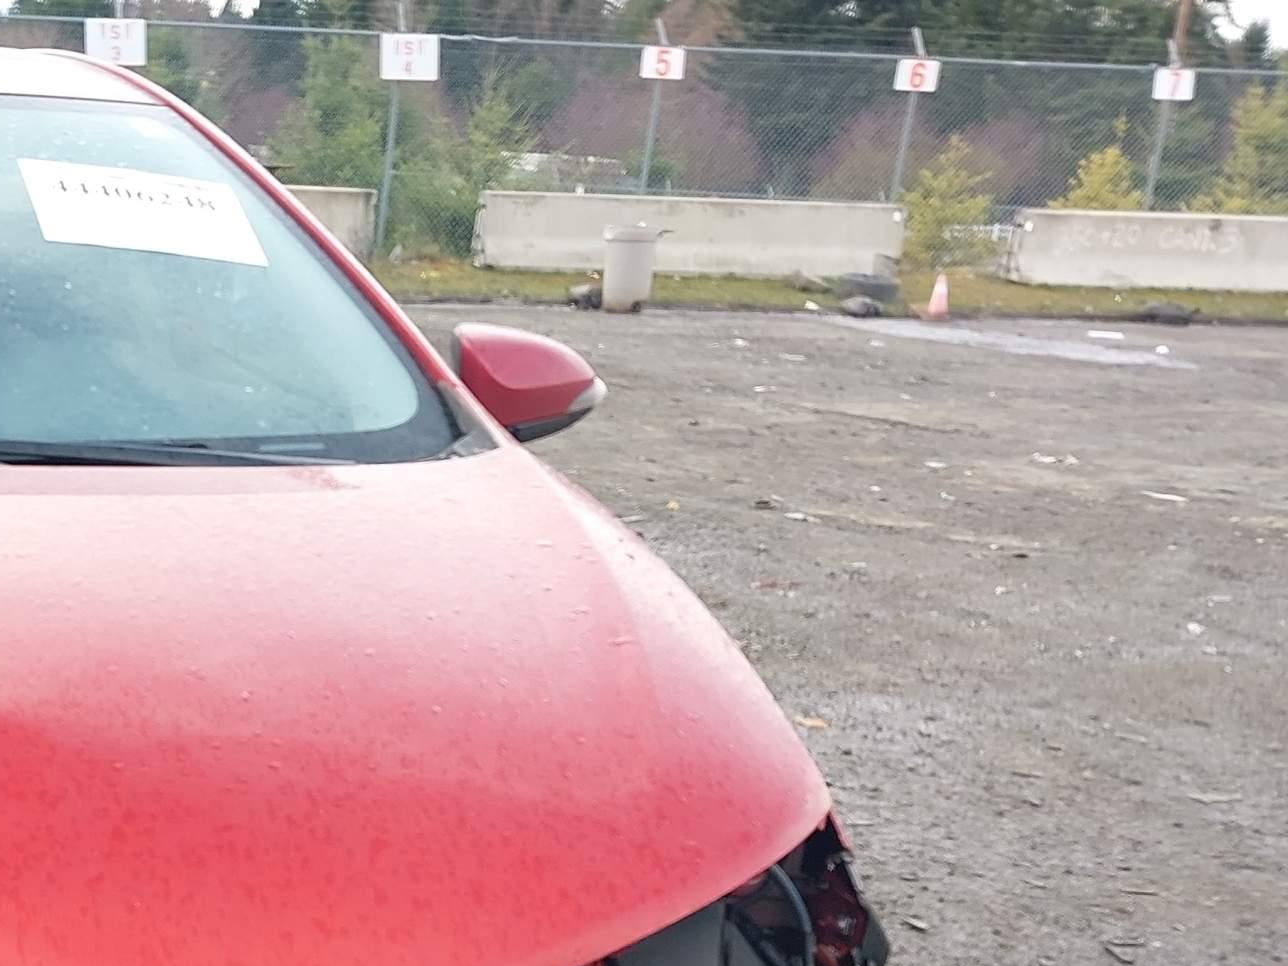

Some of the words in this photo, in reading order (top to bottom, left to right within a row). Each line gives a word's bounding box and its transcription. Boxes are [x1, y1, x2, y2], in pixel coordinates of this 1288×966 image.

[655, 49, 671, 77] 5
[910, 62, 927, 89] 6
[1169, 71, 1182, 98] 7
